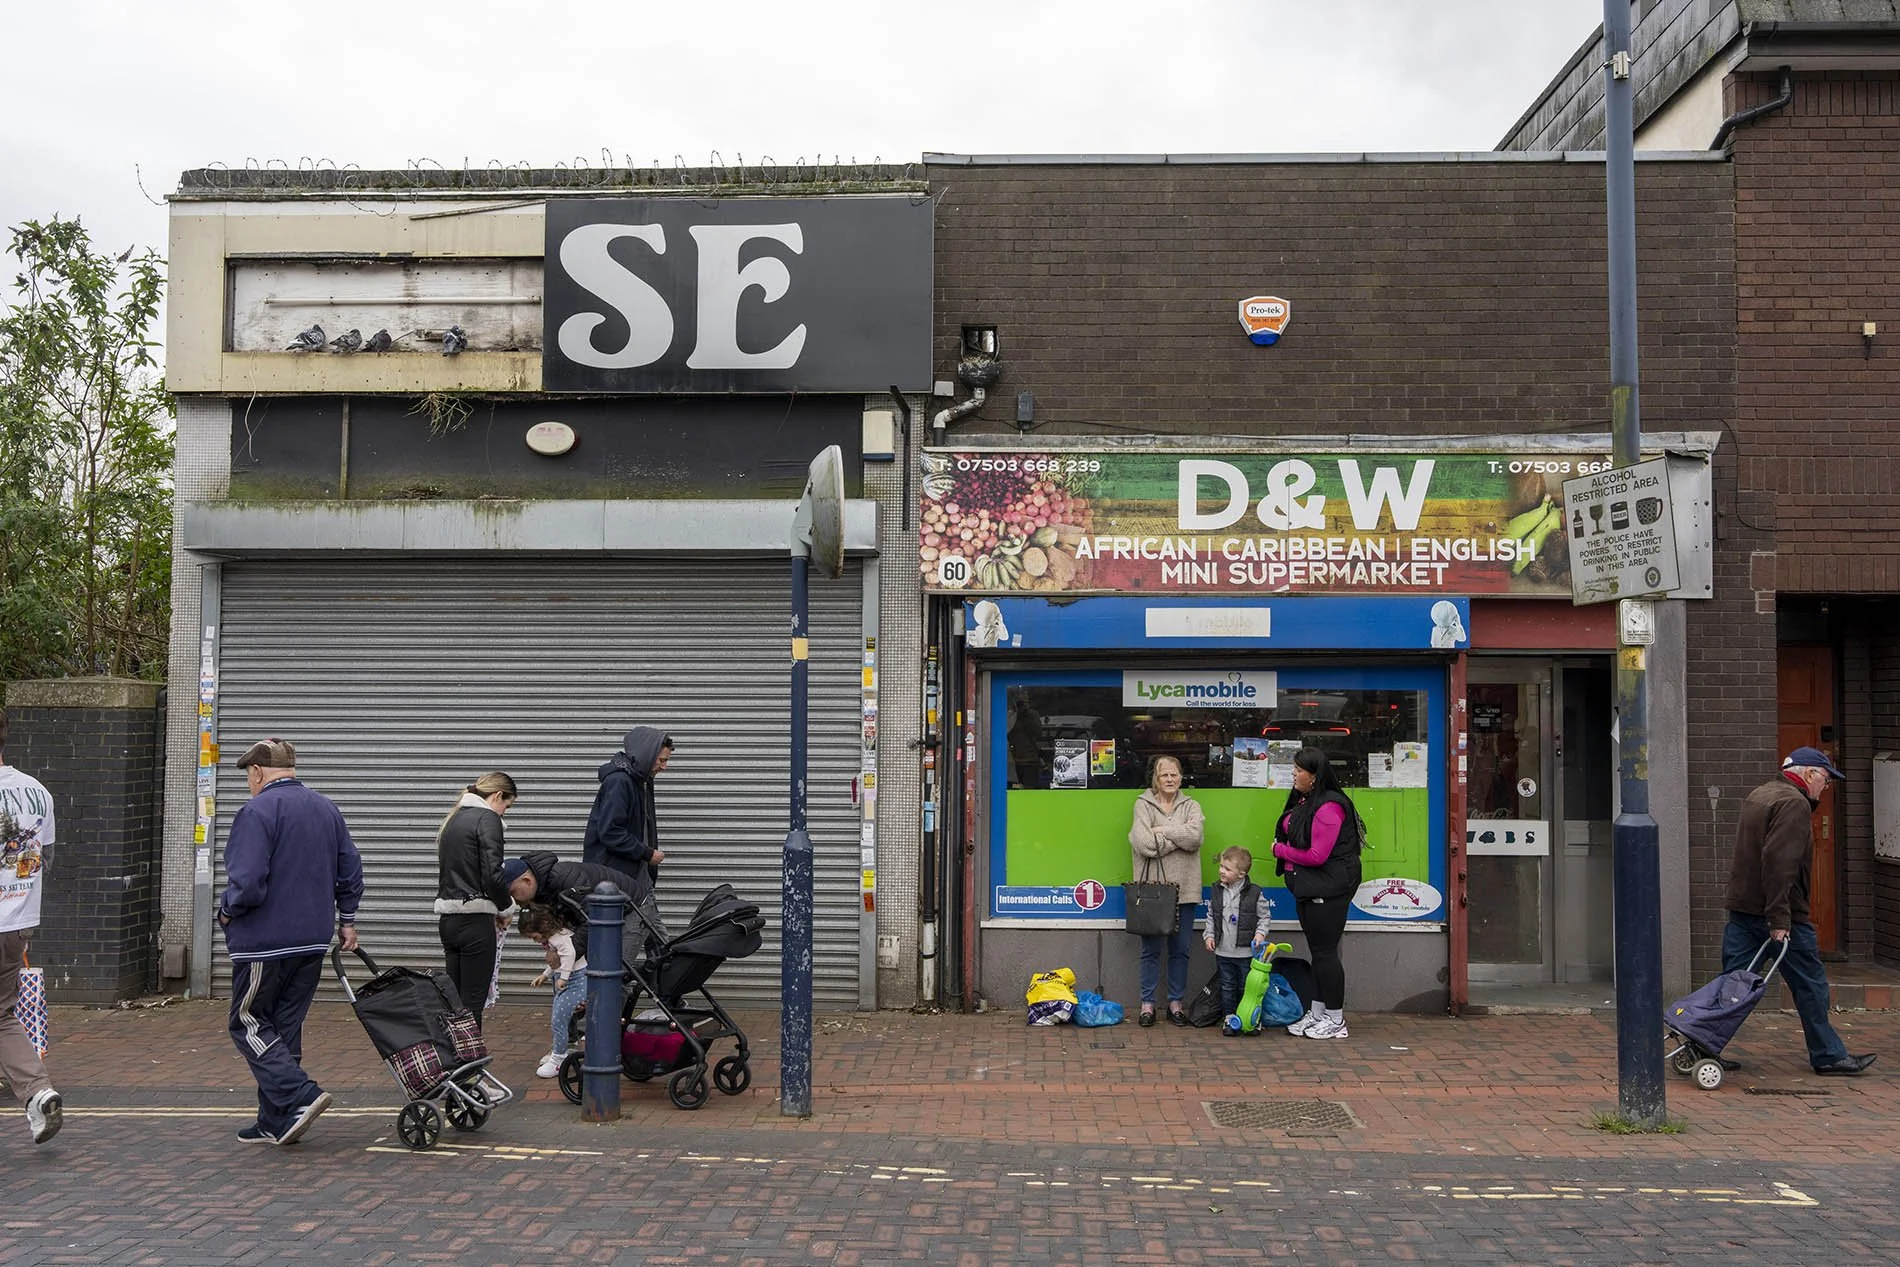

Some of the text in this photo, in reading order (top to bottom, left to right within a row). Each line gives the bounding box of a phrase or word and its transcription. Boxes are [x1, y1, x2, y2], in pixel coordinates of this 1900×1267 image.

[557, 222, 807, 369] SE
[1251, 306, 1281, 314] Pro-tek
[957, 459, 1018, 472] 07503
[1024, 459, 1060, 472] 668
[1065, 459, 1100, 472] 239
[1487, 461, 1613, 474] T: 07503 668
[1591, 470, 1636, 488] ALCOHOL
[1572, 476, 1659, 503] RESTRICTED AREA
[1579, 536, 1663, 558] POWERS TO RESTRICT
[1586, 529, 1654, 548] THE POLICE HAVE
[1075, 537, 1197, 560] AFRICAN
[1222, 537, 1385, 561] CARIBBEAN
[1412, 537, 1536, 562] ENGLISH
[1583, 546, 1661, 567] DRINKING IN PUBLIC
[943, 562, 966, 581] 60
[1161, 562, 1449, 585] MINI SUPERMARKET
[1595, 557, 1648, 573] IN THIS AREA
[1137, 680, 1257, 700] Lycamobile
[999, 895, 1051, 904] International
[1052, 895, 1073, 904] Calls
